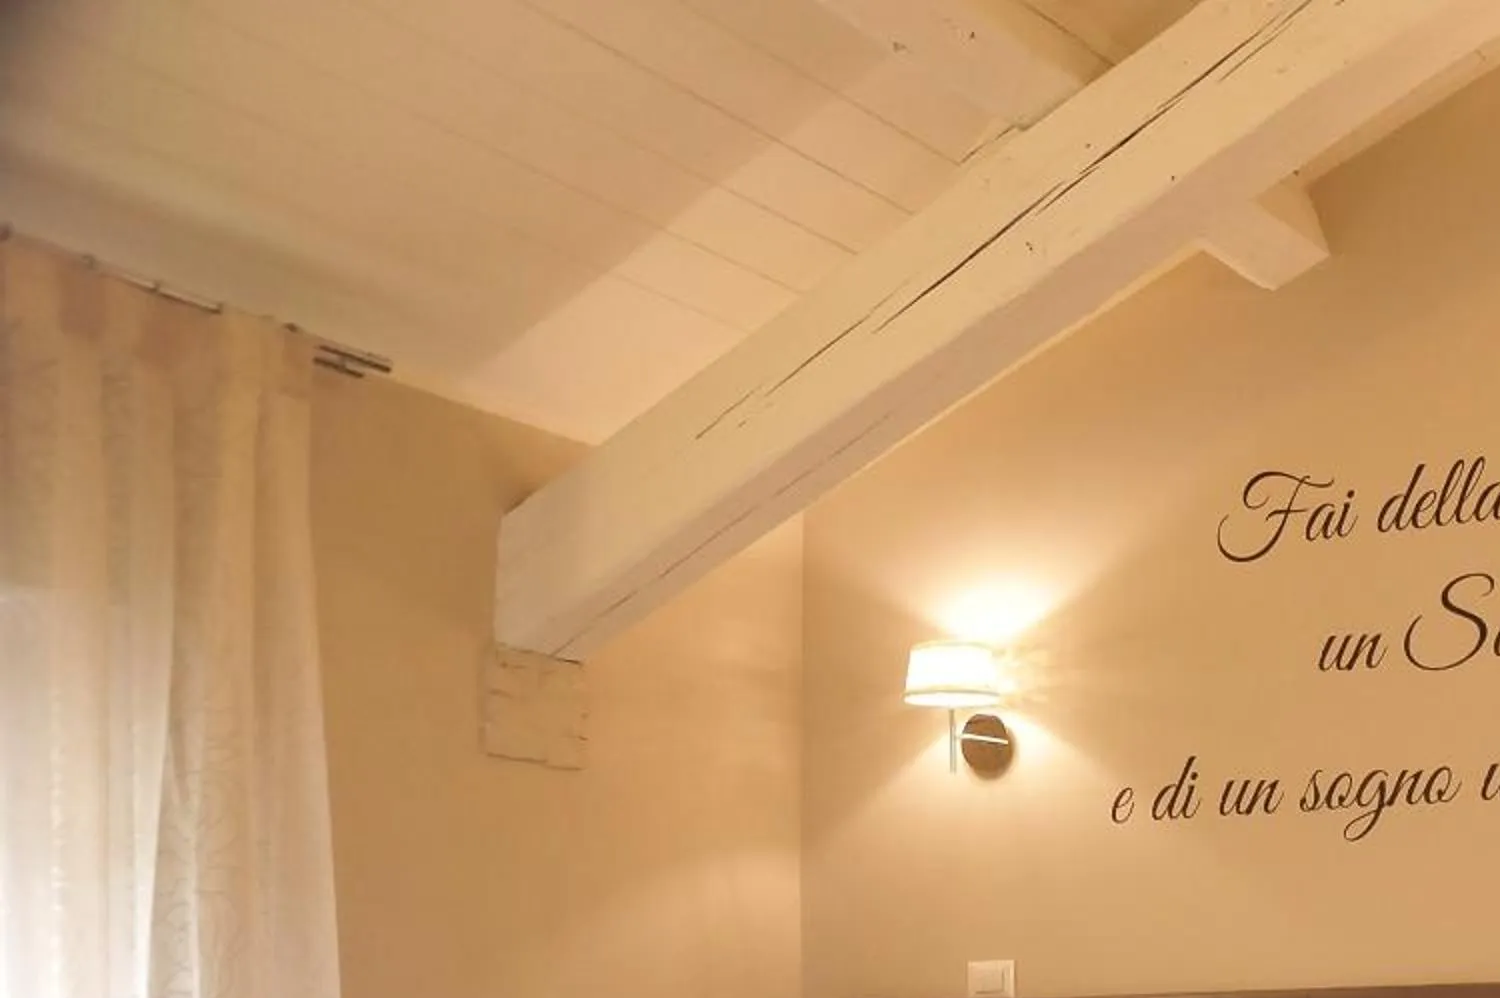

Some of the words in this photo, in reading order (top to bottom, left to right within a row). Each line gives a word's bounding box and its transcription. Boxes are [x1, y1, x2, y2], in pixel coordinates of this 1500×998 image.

[1217, 470, 1358, 563] Fai
[1317, 630, 1388, 673] un
[1111, 784, 1135, 825] e
[1151, 755, 1202, 822] di
[1218, 777, 1286, 817] un
[1299, 764, 1463, 843] sogno
